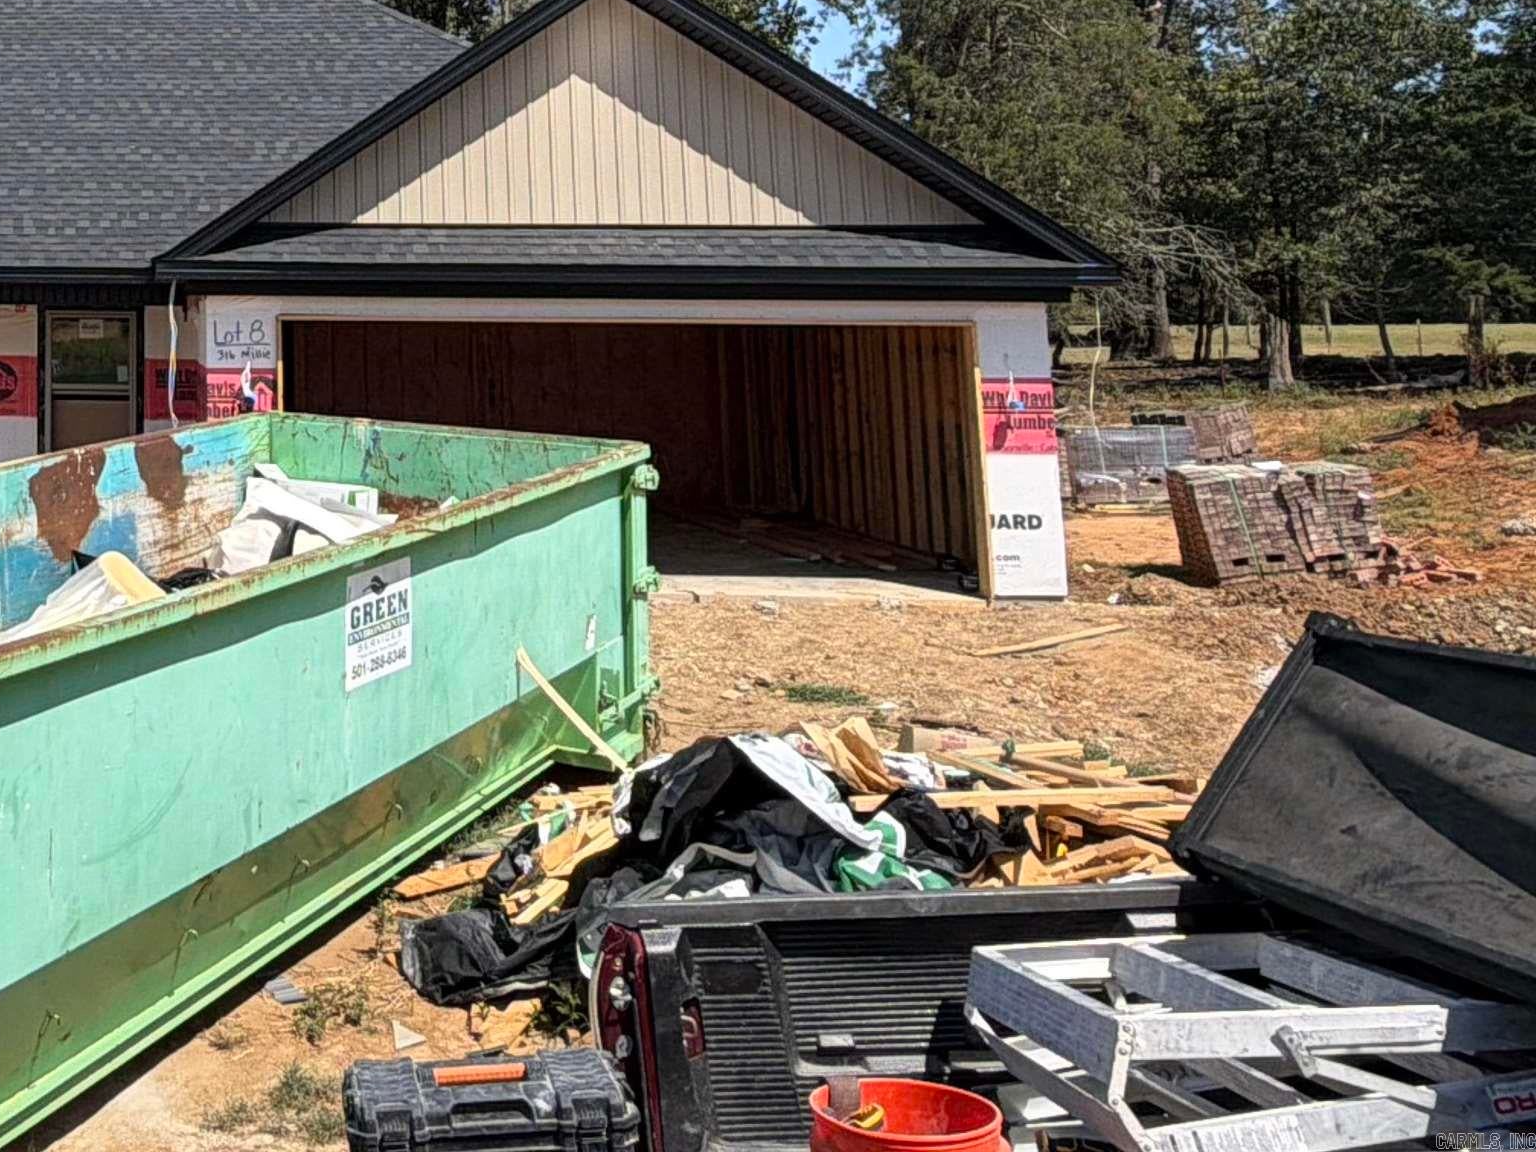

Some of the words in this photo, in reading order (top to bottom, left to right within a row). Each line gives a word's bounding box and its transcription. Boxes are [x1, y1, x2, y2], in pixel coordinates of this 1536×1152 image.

[214, 320, 243, 346] Lot
[249, 319, 265, 344] 8
[350, 588, 409, 630] GREEN
